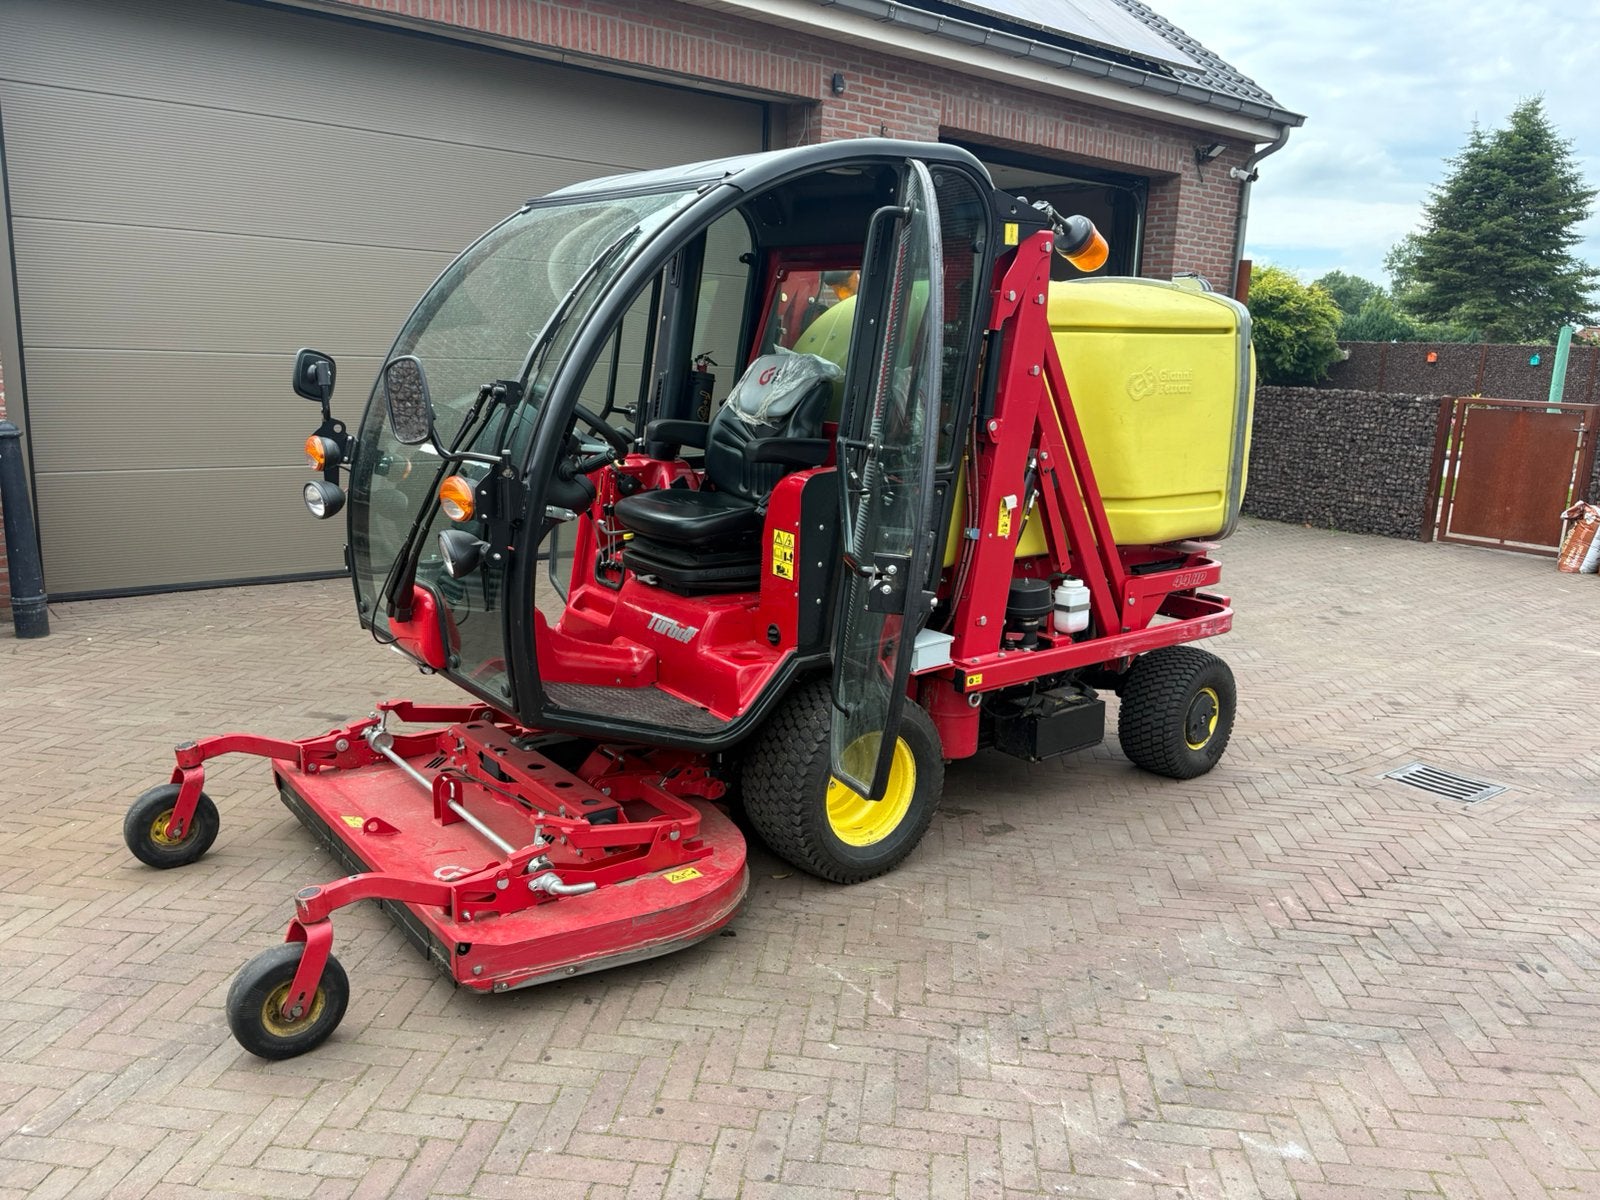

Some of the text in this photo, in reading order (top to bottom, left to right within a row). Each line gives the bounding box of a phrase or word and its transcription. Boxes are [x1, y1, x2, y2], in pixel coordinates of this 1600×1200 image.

[1159, 368, 1193, 382] Gianni
[1158, 382, 1193, 396] Ferrari
[646, 612, 701, 645] Turbo4
